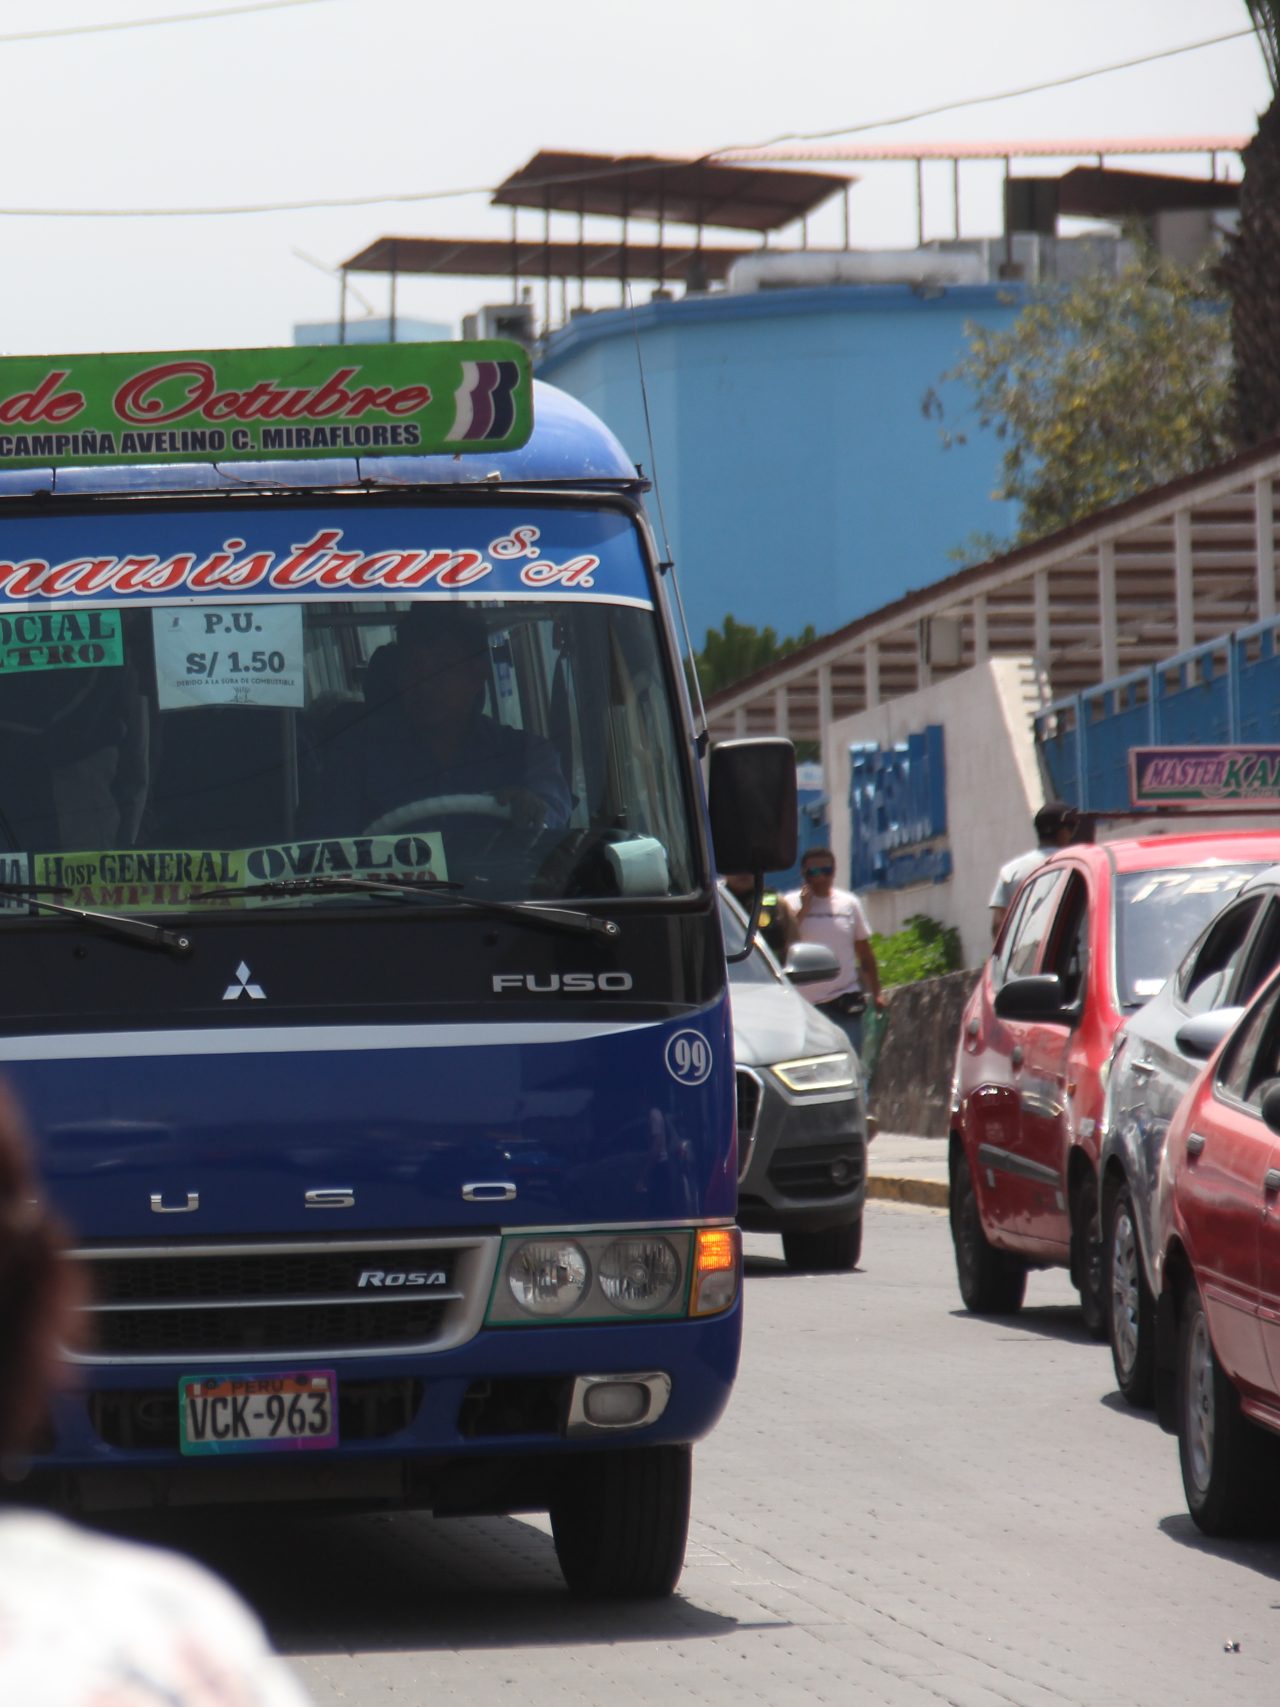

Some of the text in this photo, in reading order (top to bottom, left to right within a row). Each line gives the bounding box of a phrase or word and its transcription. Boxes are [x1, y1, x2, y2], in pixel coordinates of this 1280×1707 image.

[112, 361, 433, 426] Octubre
[120, 428, 226, 454] AVELINO
[231, 429, 257, 451] C.
[261, 423, 421, 449] MIRAFLORES
[204, 612, 263, 634] P.U.
[186, 651, 285, 678] S/ 1.50
[176, 679, 203, 687] DEBIDO
[251, 678, 295, 687] COMBUSTIBLE
[99, 852, 239, 884] GENERAL
[247, 837, 432, 880] OVALO
[492, 972, 633, 992] FUSO
[673, 1038, 707, 1075] 99
[26, 1182, 518, 1214] USO
[232, 1380, 284, 1394] PERU
[190, 1393, 327, 1440] VCK-963
